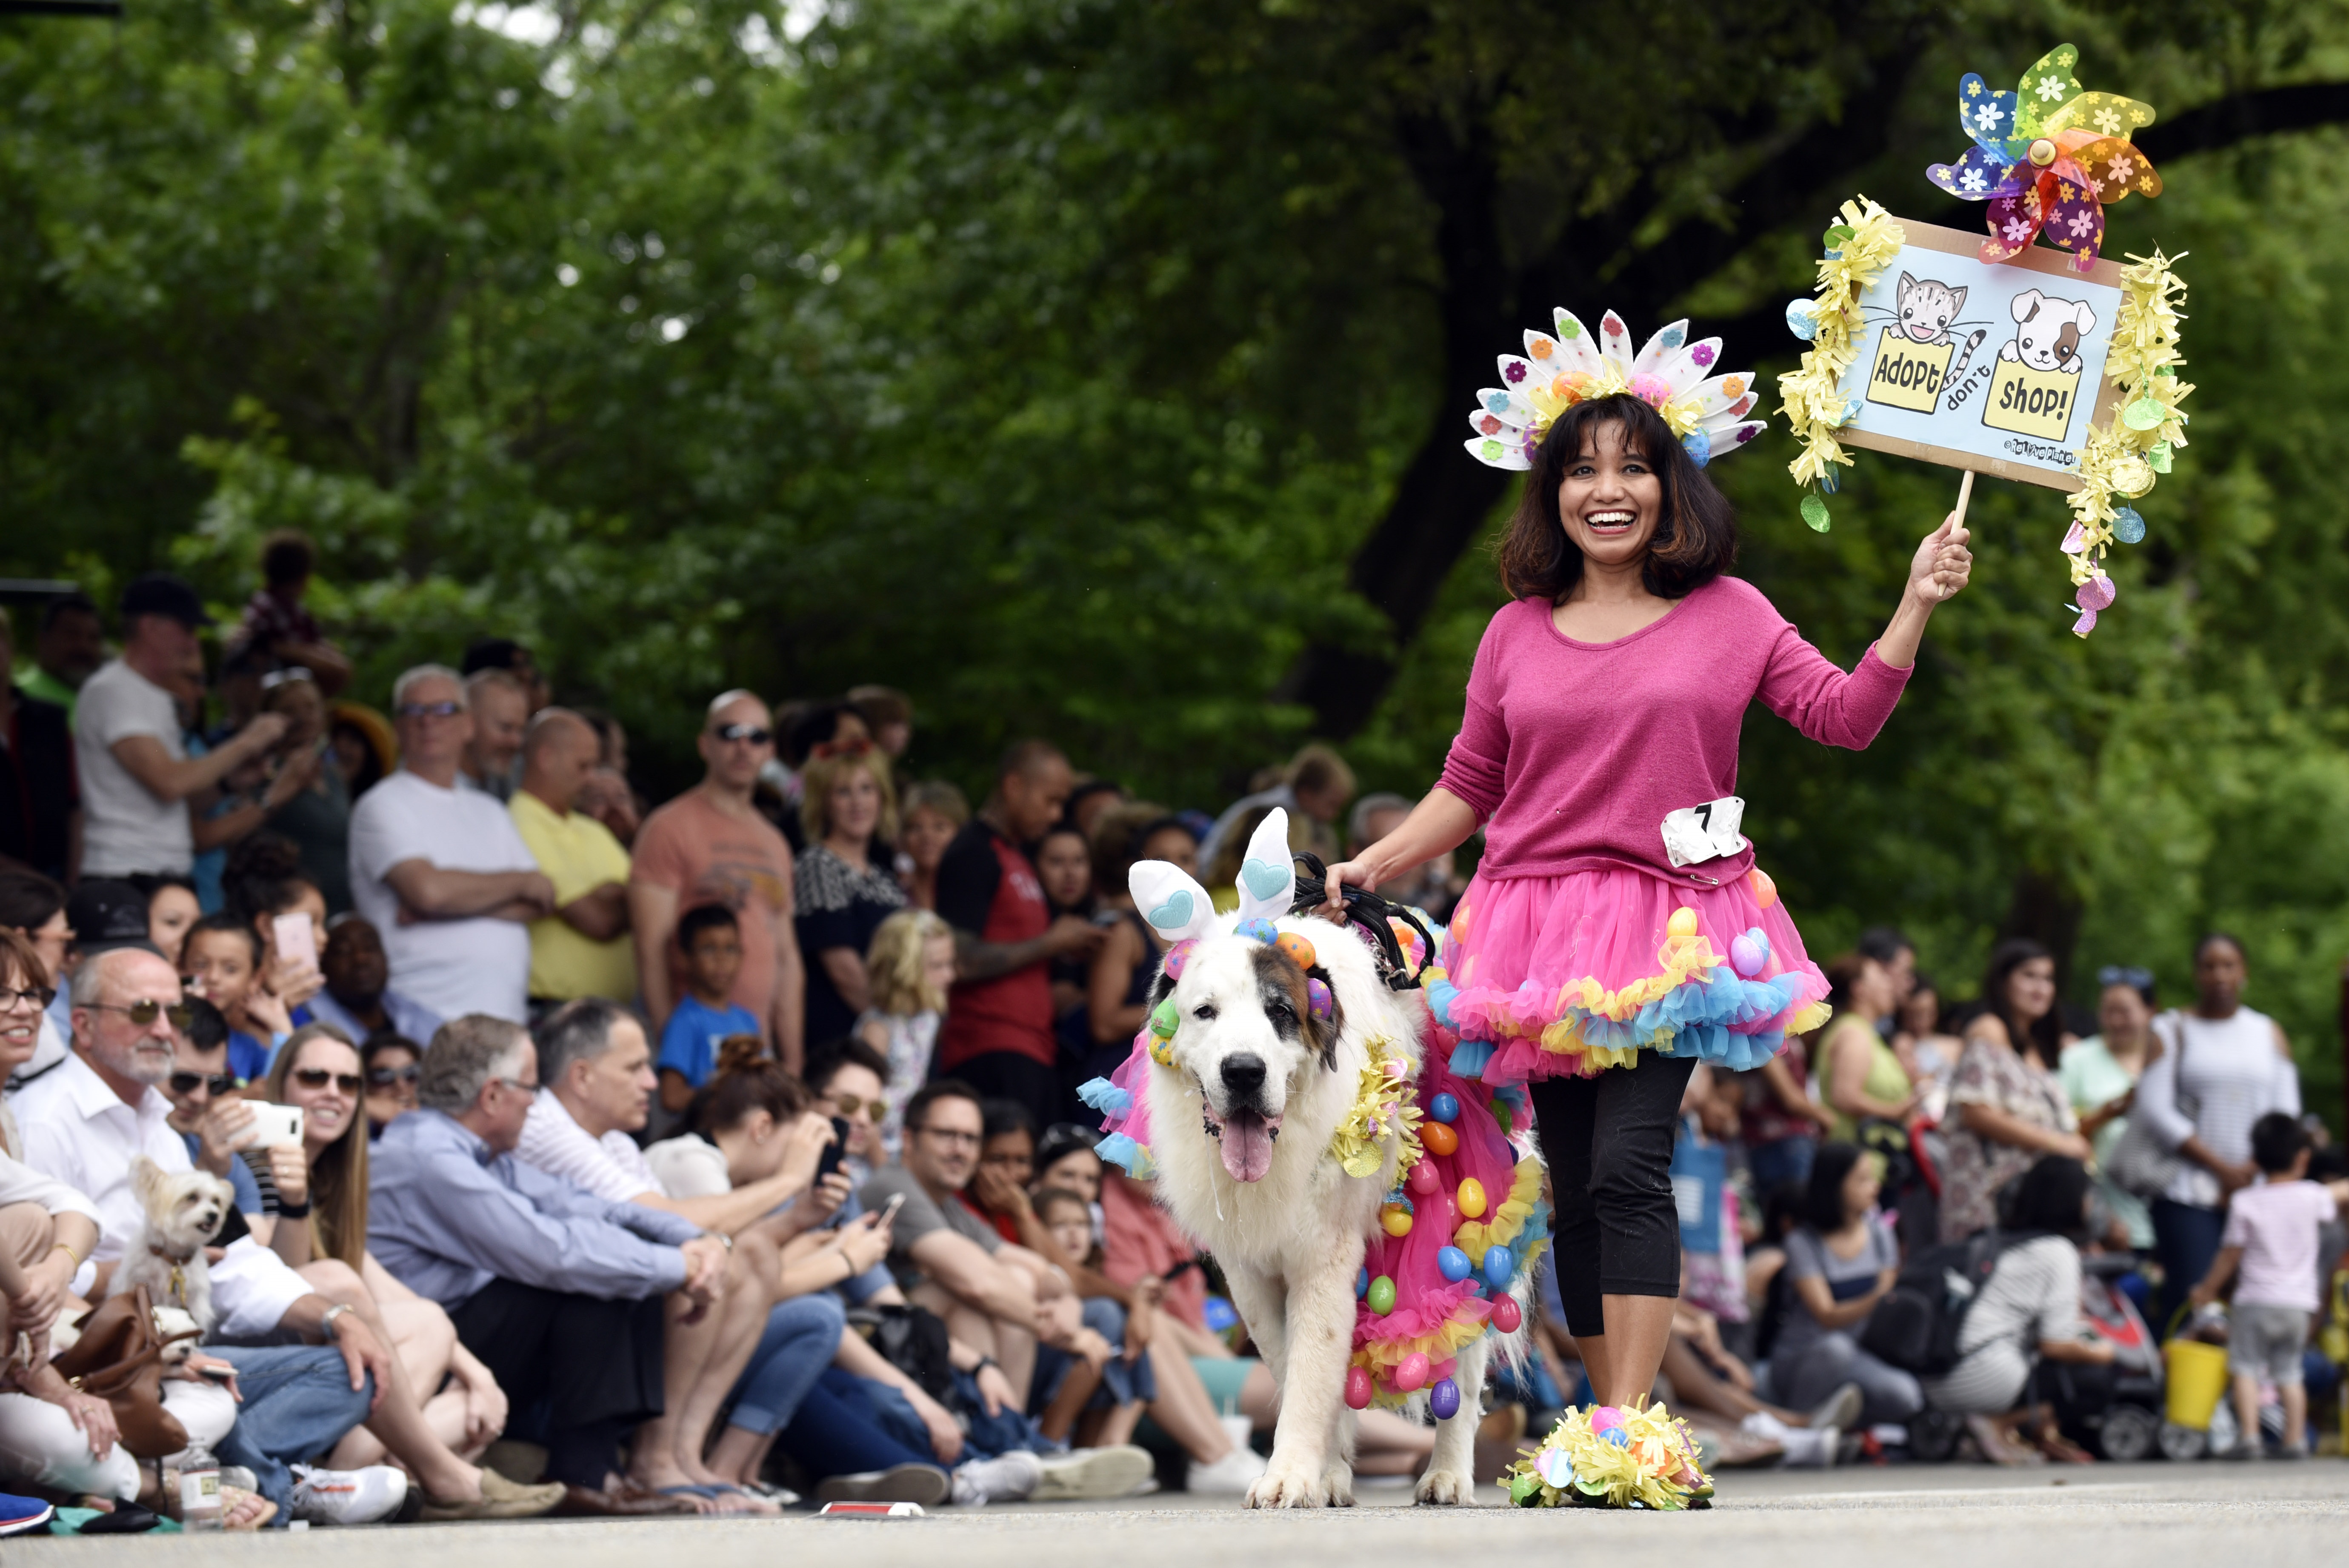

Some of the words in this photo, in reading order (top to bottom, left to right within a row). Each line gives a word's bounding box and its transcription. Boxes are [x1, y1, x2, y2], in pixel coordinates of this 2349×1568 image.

[1874, 352, 1940, 394] Adopt
[1947, 365, 1991, 411] don't
[1694, 803, 1712, 836] 7
